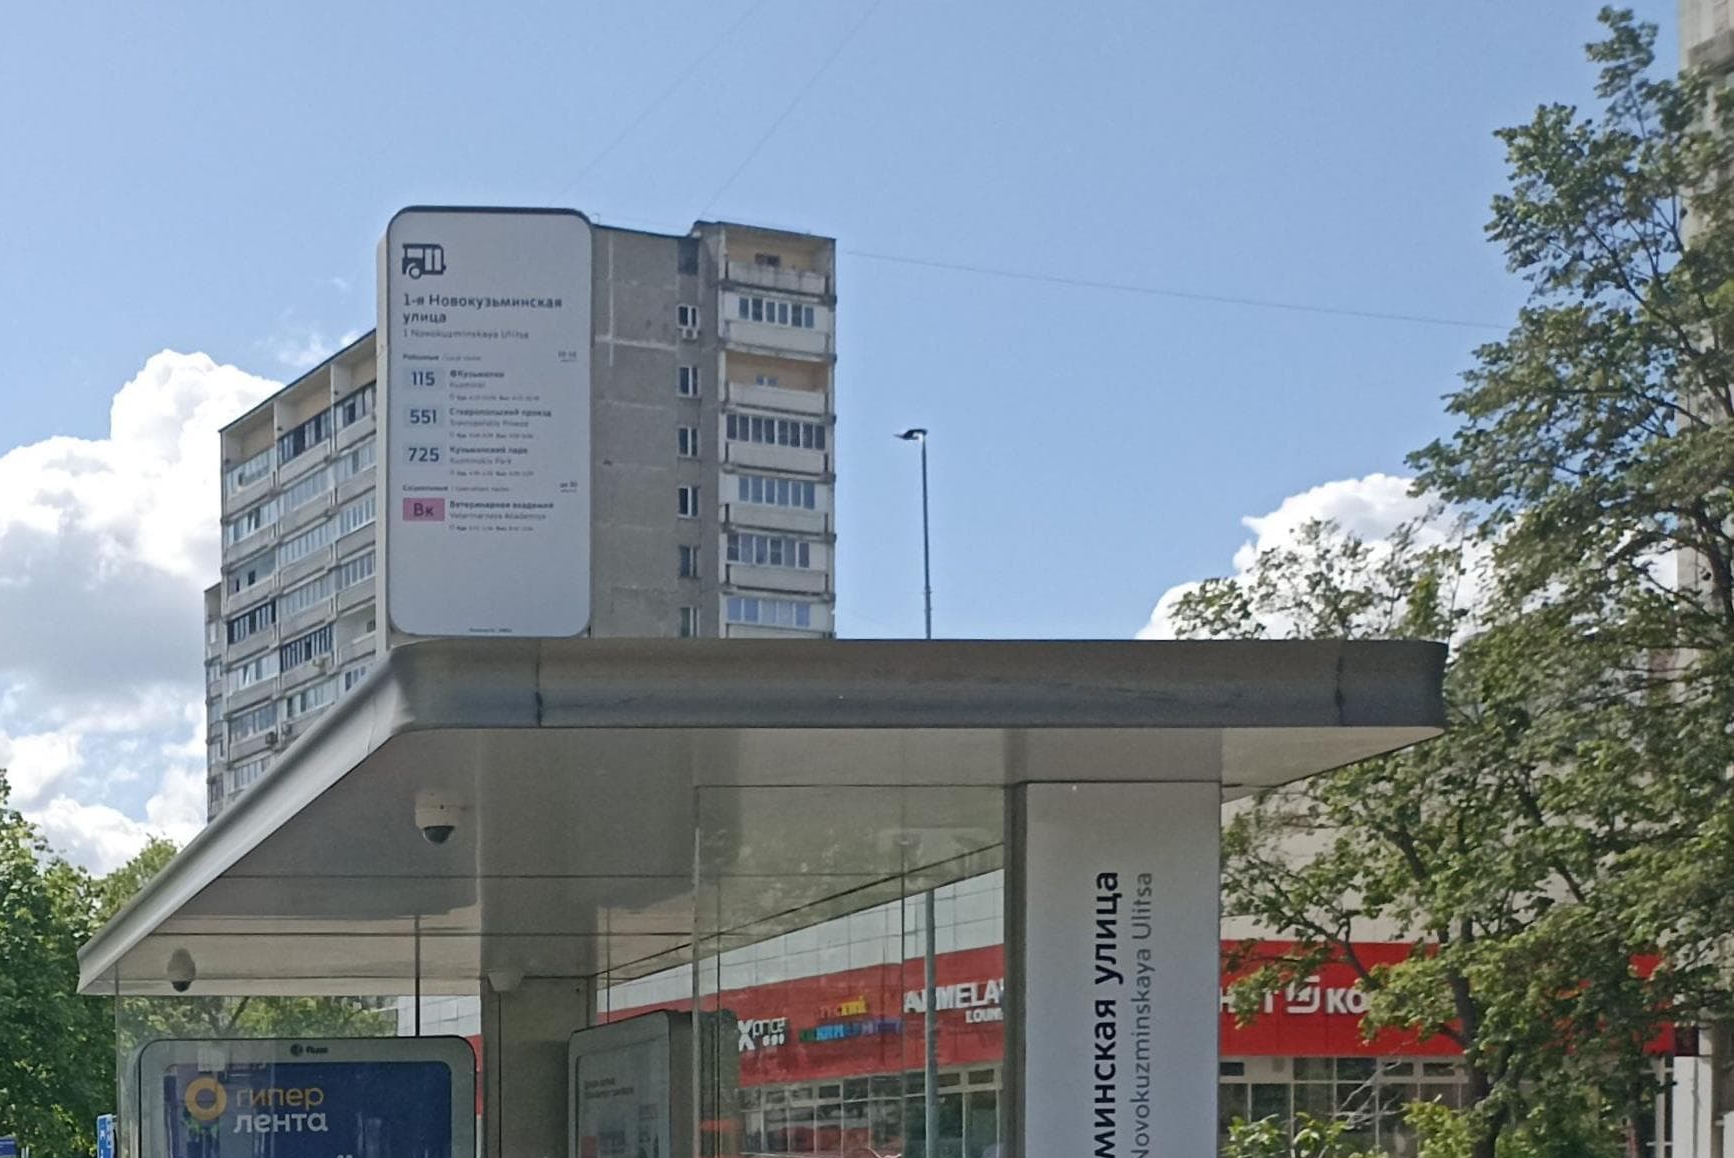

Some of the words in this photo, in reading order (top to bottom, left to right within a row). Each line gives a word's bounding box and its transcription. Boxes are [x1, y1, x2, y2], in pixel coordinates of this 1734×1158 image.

[403, 293, 425, 307] 1-я
[428, 294, 563, 309] Новокузьминская
[402, 312, 447, 325] улица
[412, 371, 436, 387] 115
[409, 409, 437, 425] 551
[408, 447, 440, 463] 725
[1129, 871, 1153, 940] Ulitsa
[1094, 871, 1124, 985] улица
[235, 1085, 325, 1108] гипер
[233, 1111, 328, 1134] лента
